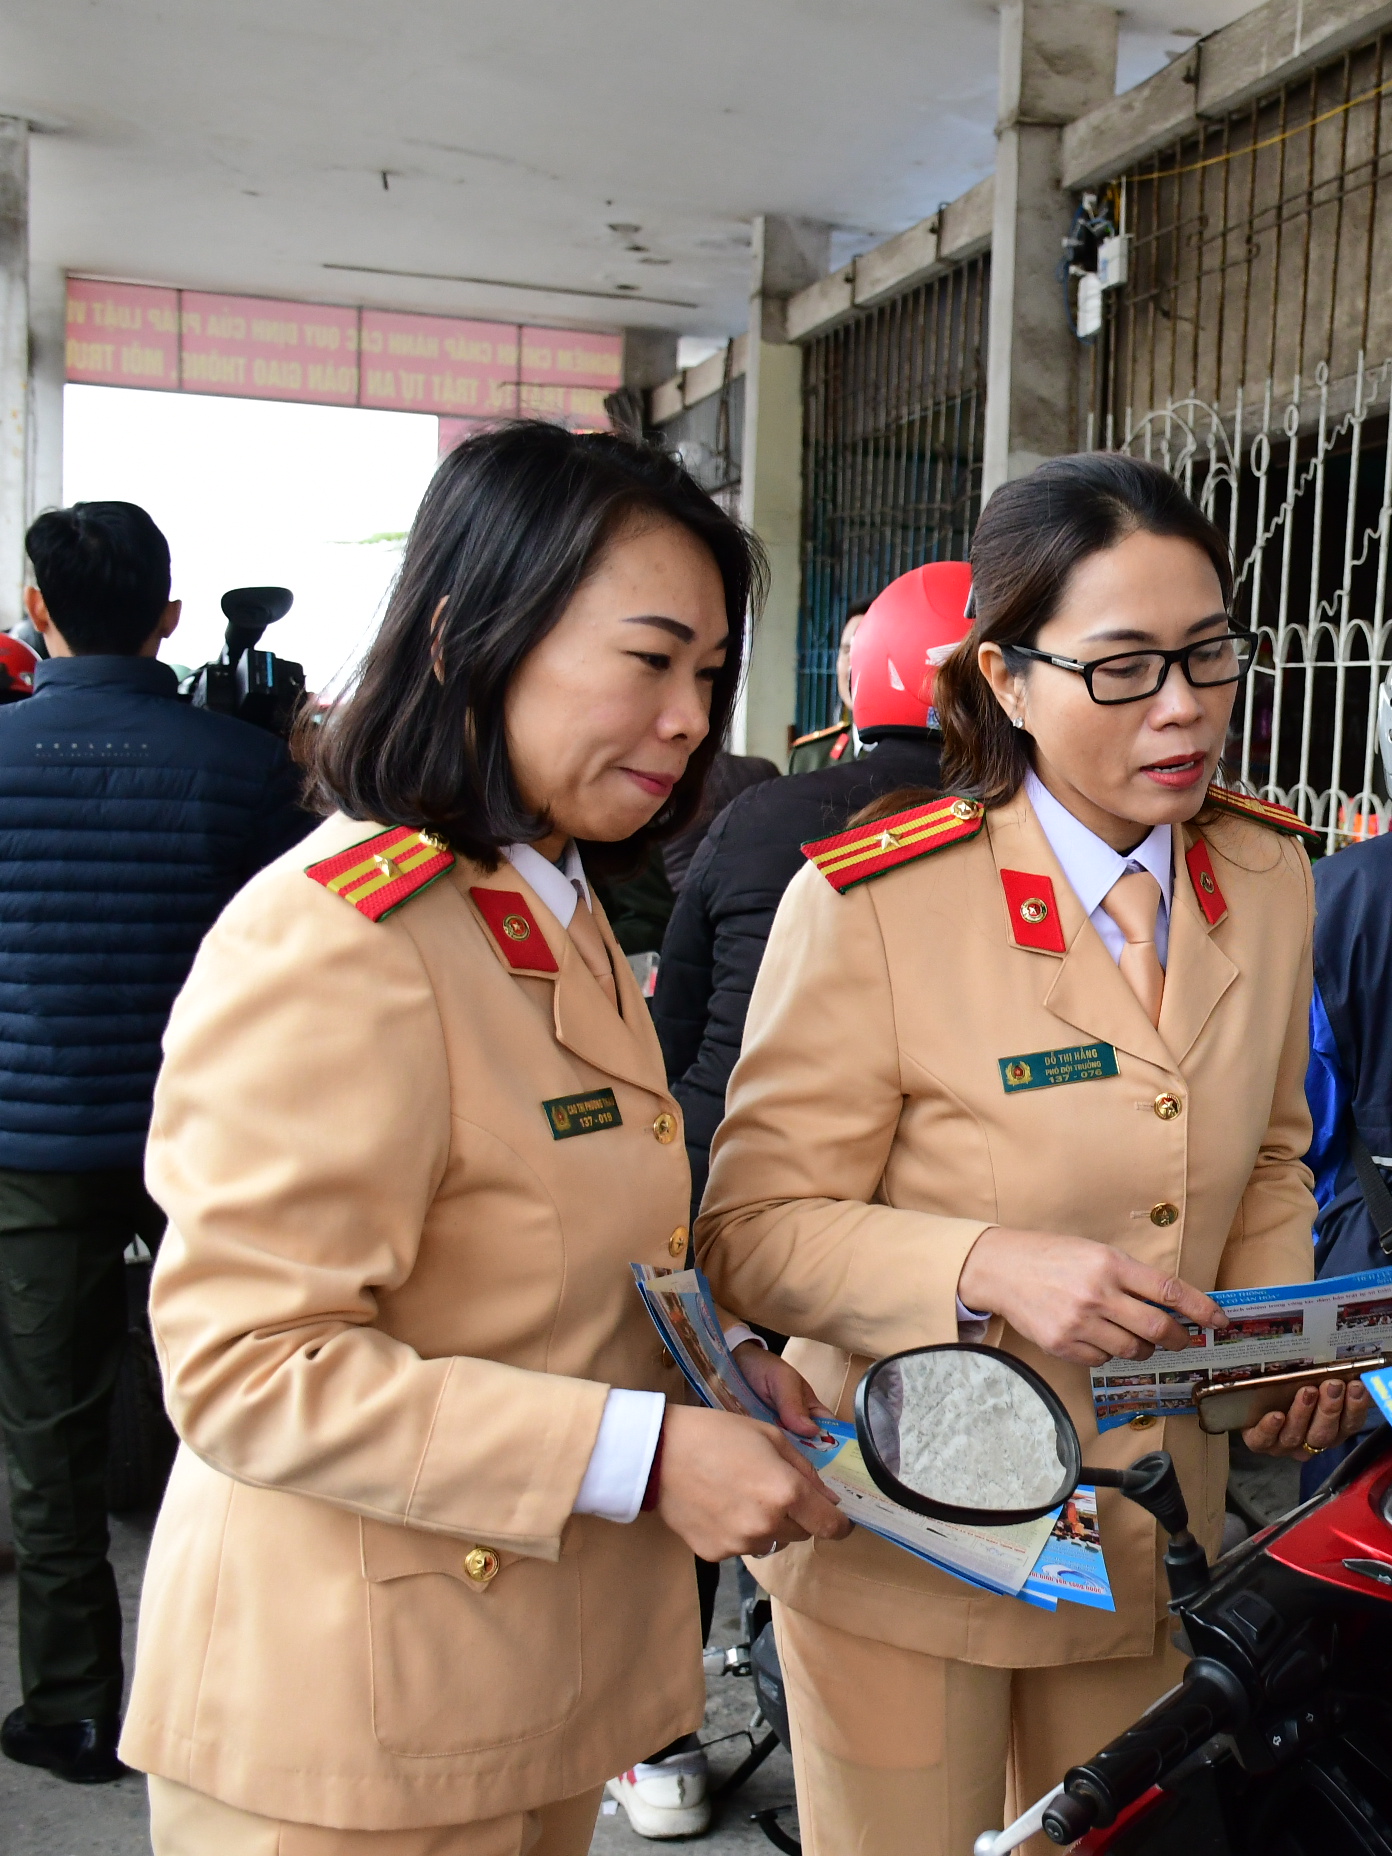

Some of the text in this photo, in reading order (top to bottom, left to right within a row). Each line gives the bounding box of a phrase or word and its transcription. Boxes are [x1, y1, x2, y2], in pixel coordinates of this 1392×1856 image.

[1058, 1053, 1073, 1064] THỊ
[1048, 1074, 1070, 1084] 137
[1080, 1069, 1103, 1079] 076
[580, 1116, 592, 1127] 137
